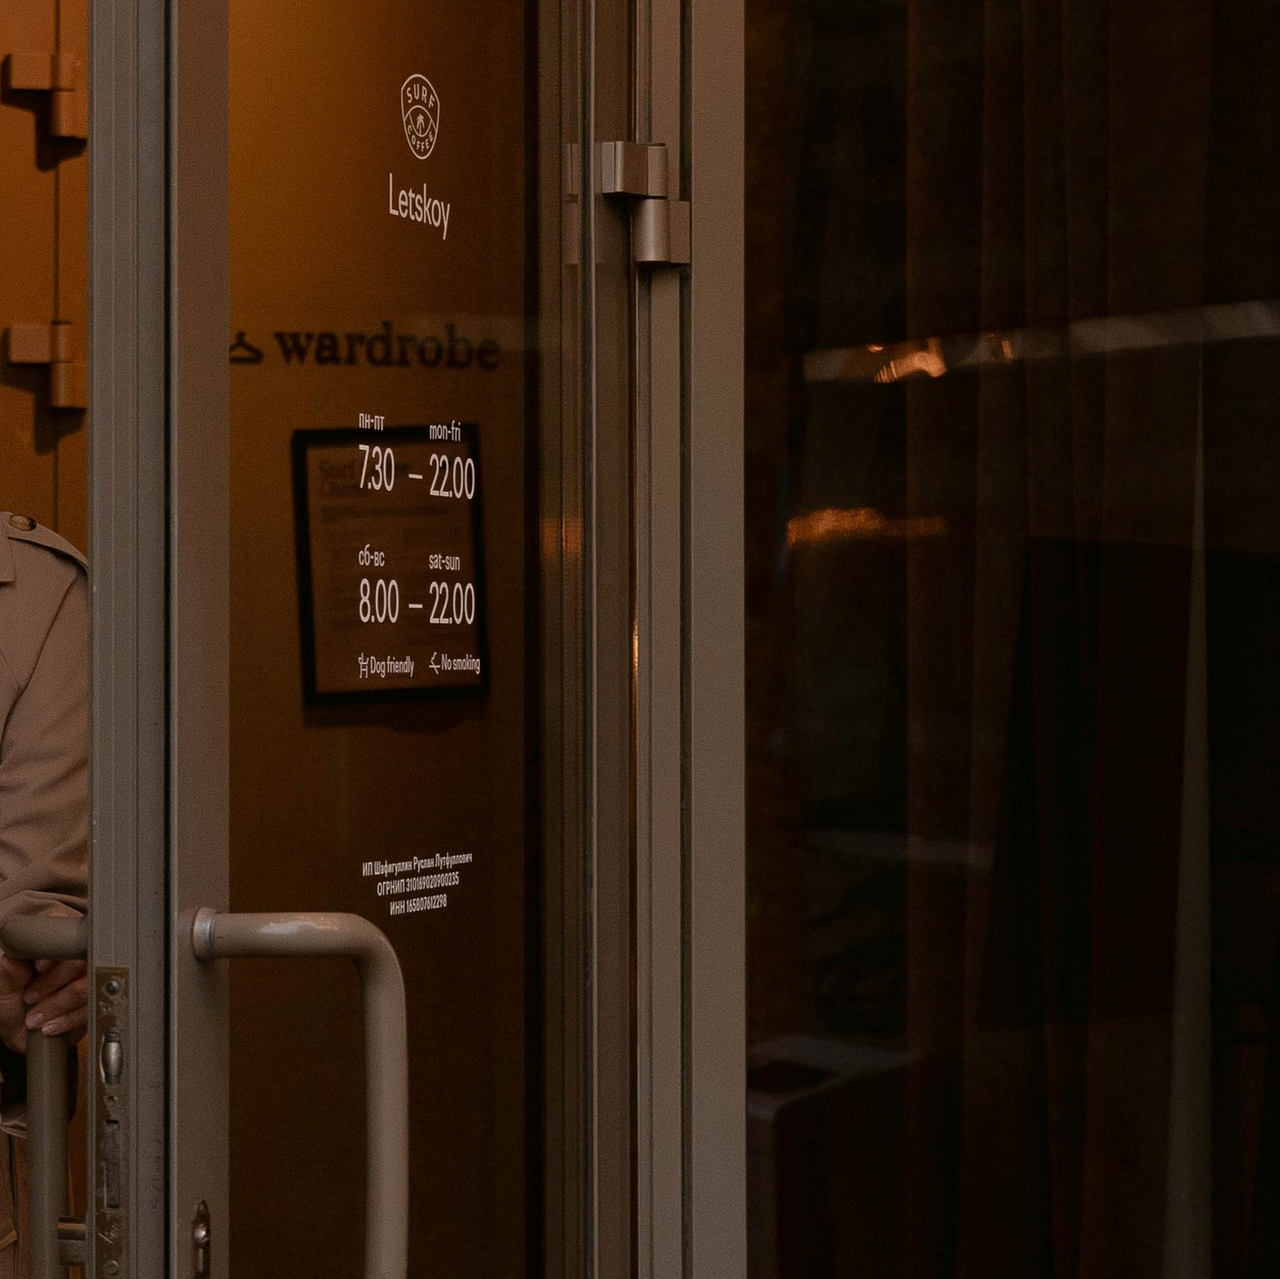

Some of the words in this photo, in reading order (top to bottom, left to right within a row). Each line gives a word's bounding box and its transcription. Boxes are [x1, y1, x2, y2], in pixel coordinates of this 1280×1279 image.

[406, 83, 436, 109] SURF
[407, 124, 434, 153] COFFEE
[389, 172, 451, 240] Letskoy
[274, 321, 501, 370] wardrobe
[359, 412, 385, 432] пн-пт
[429, 419, 461, 442] mon-fri
[358, 444, 395, 492] 7.30
[429, 453, 475, 500] 22.00
[358, 544, 385, 567] сб-вс
[429, 553, 460, 571] sat-sun
[359, 578, 399, 623] 8.00
[429, 581, 475, 625] 22.00
[370, 656, 386, 678] Dog
[387, 655, 415, 678] friendly
[441, 653, 452, 671] No
[453, 653, 481, 674] smoking
[362, 860, 373, 877] ИП
[413, 856, 435, 873] Руслан
[377, 878, 405, 896] ОГРНИП
[390, 900, 405, 916] ИНН
